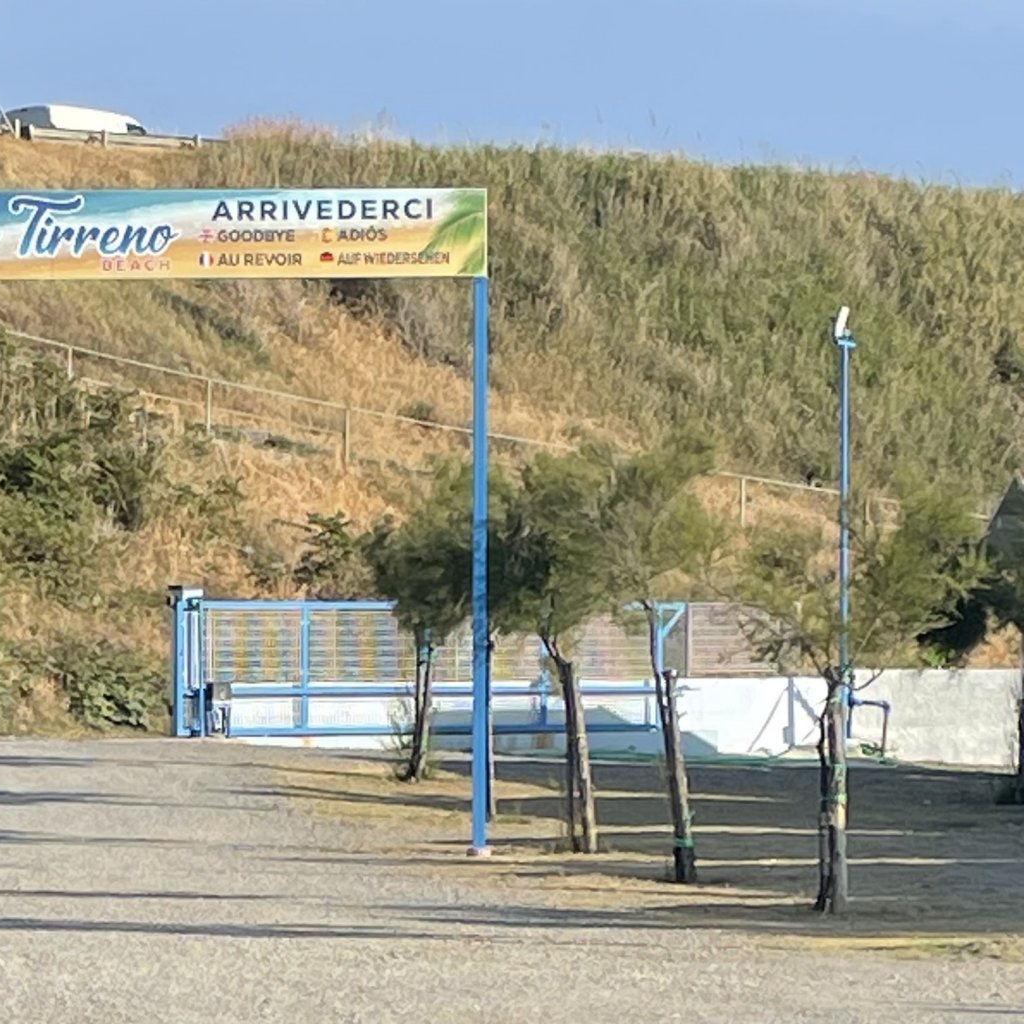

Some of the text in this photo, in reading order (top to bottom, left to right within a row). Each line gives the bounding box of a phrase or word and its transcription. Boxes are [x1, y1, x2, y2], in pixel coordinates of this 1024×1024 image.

[212, 198, 433, 221] ARRIVEDERCI
[9, 195, 180, 257] Tirreno
[337, 225, 388, 241] ADIÓS
[217, 229, 295, 243] GOODBYE
[102, 259, 170, 272] BEACH
[217, 253, 302, 267] AU REVOIR
